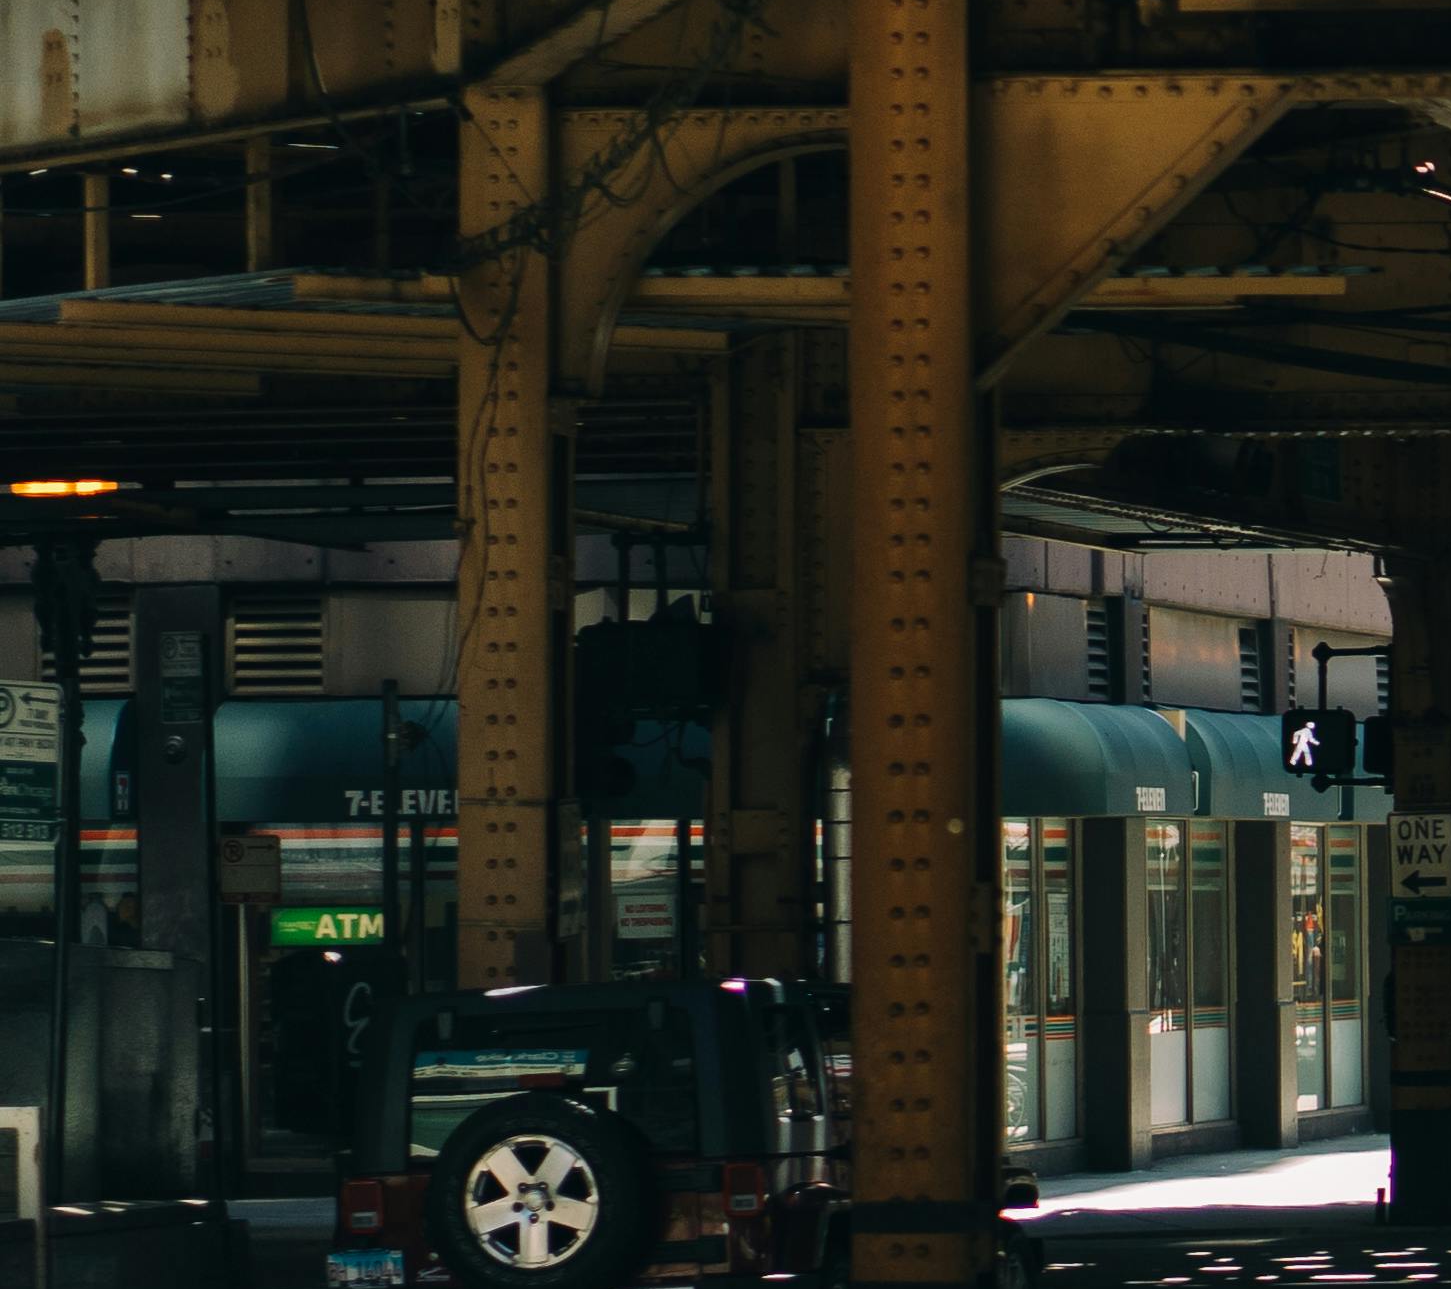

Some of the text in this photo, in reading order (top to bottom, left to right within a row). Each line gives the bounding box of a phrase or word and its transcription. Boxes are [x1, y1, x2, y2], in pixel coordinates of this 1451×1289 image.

[345, 789, 459, 816] 7-EEVE
[1397, 819, 1445, 841] ONE
[1396, 843, 1447, 865] WAY
[315, 913, 385, 939] ATM
